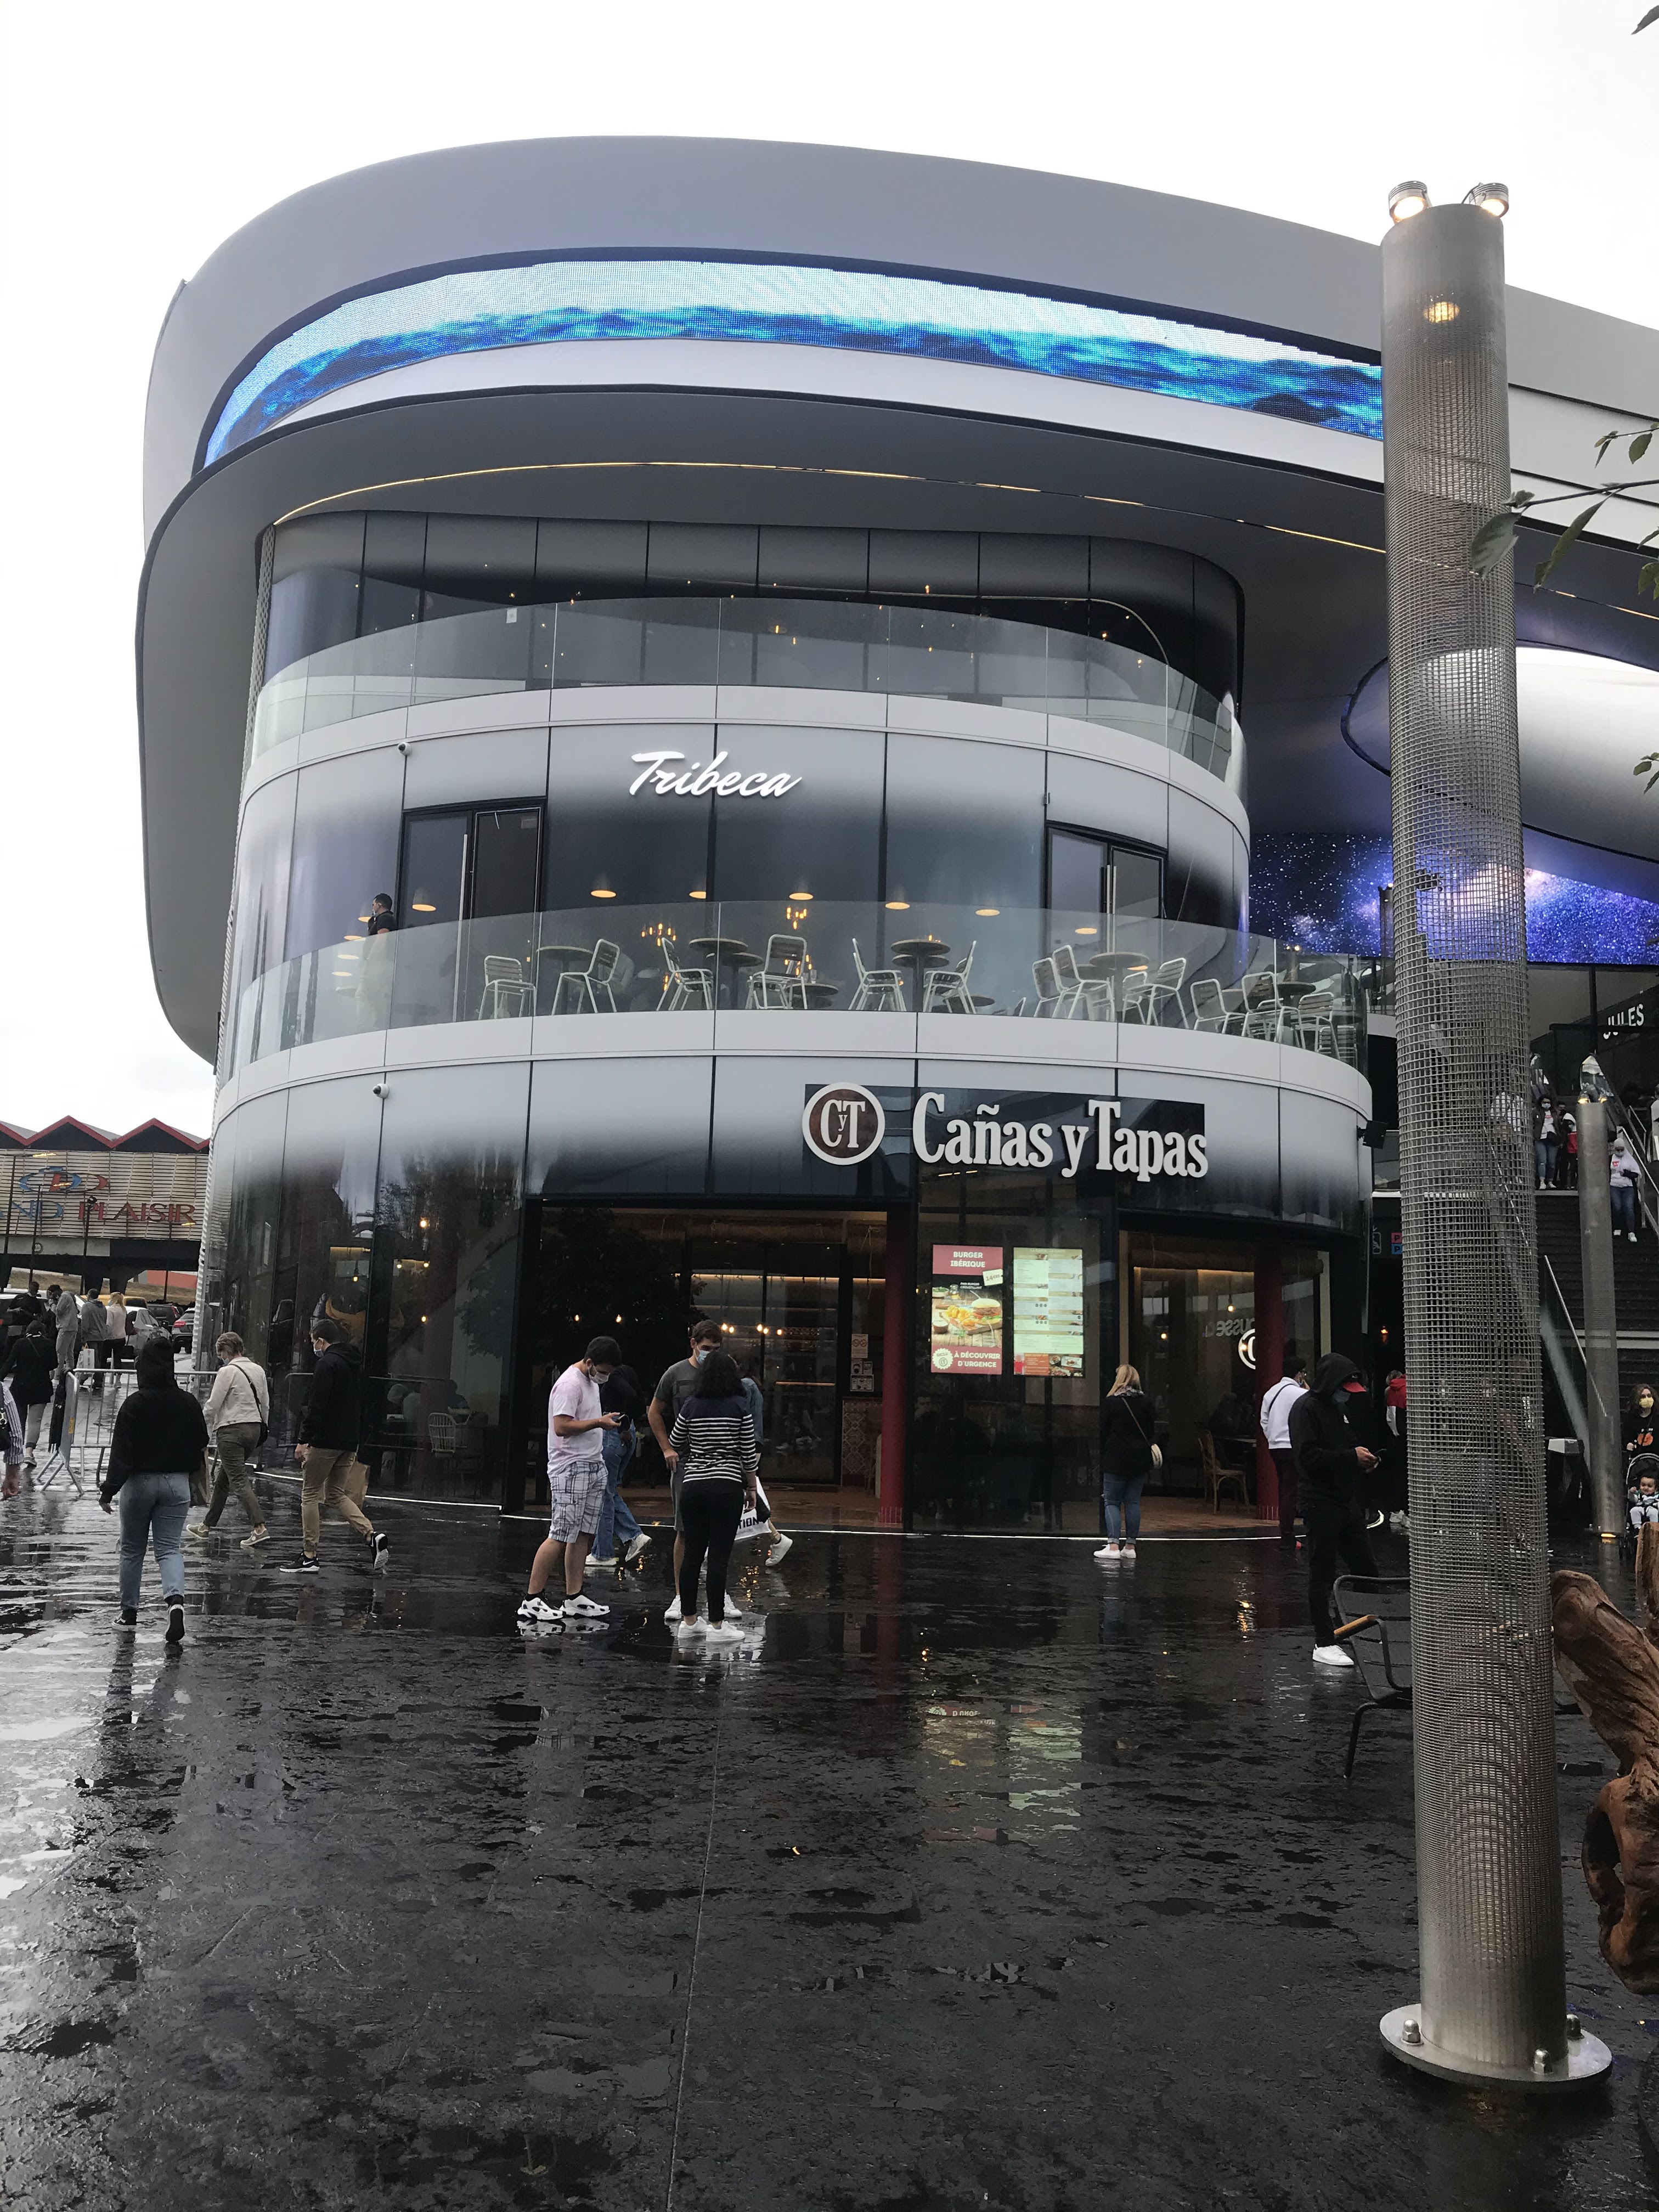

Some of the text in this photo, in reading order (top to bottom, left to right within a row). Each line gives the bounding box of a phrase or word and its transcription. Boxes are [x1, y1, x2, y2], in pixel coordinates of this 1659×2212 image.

[629, 751, 802, 797] Tribeca
[1603, 1003, 1644, 1040] JULES
[912, 1092, 1209, 1182] Cañas y Tapas
[78, 1201, 196, 1223] PLAISIR
[950, 1259, 986, 1268] IBÉRIQUE
[953, 1350, 1001, 1359] À DÉCOUVRIR
